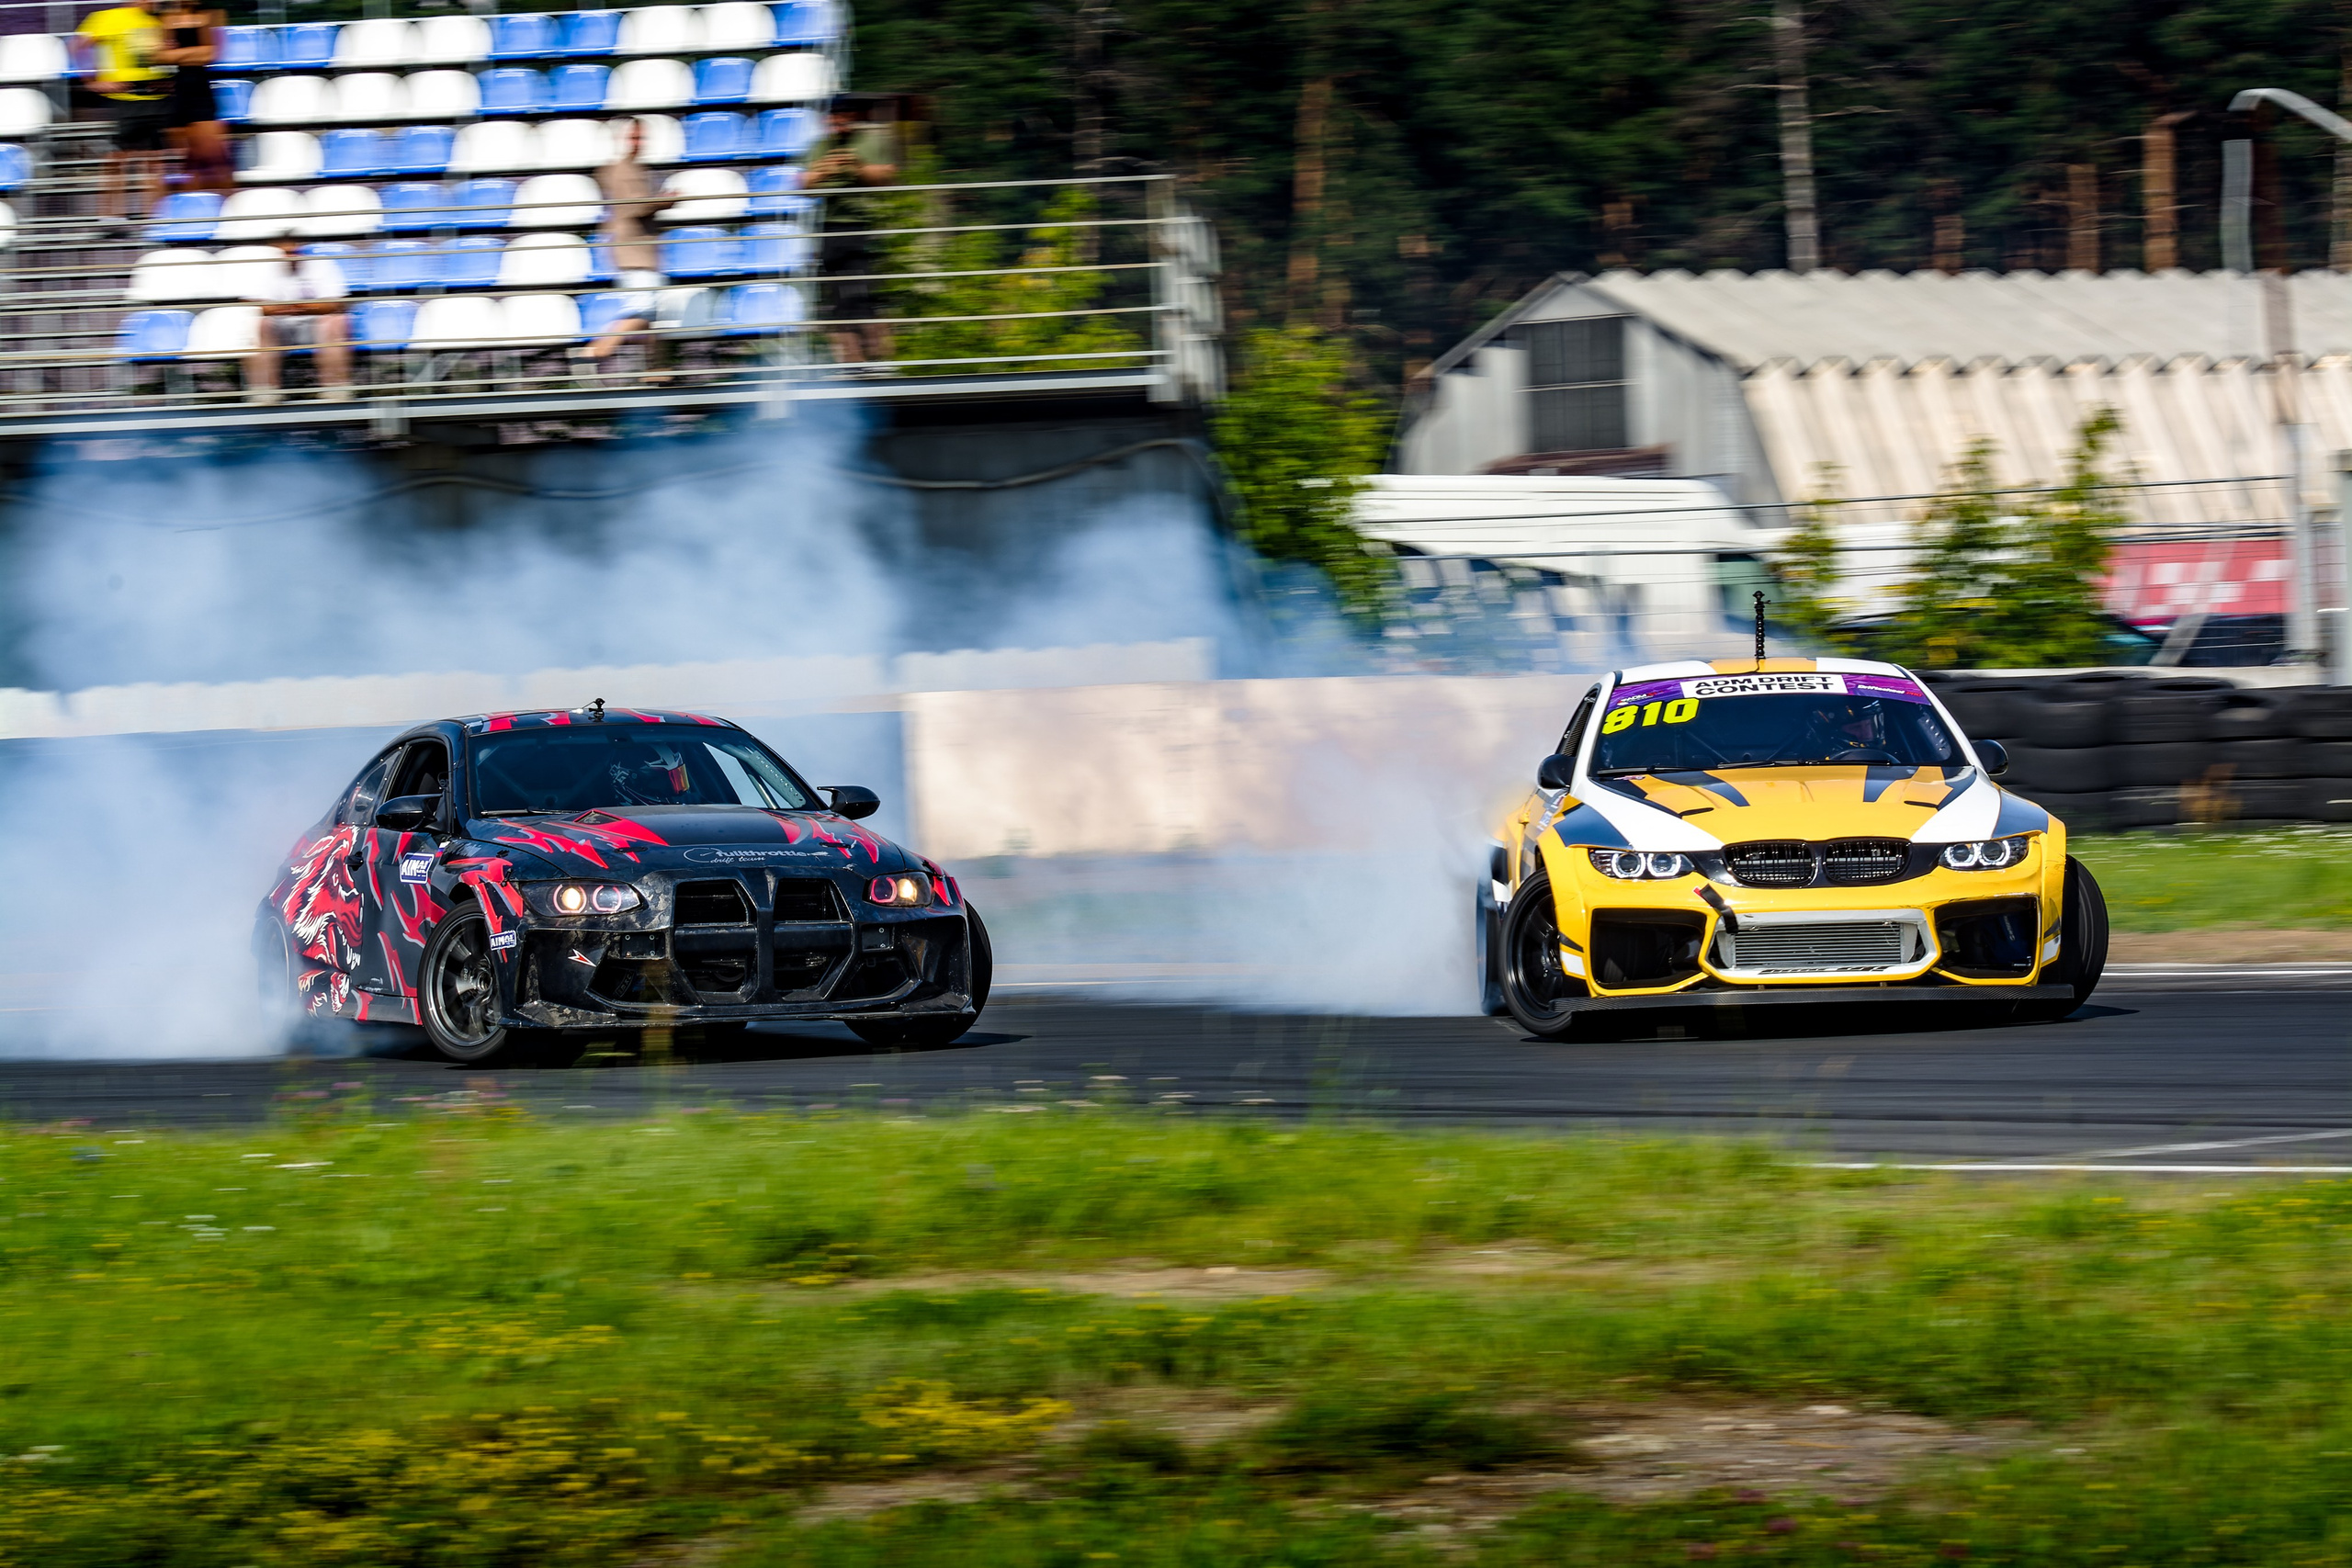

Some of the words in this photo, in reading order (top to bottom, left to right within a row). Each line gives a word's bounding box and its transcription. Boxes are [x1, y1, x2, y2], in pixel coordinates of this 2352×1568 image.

[1695, 678, 1752, 688] ADM
[1695, 682, 1834, 695] CONTEST
[1601, 698, 1700, 735] 810
[715, 849, 808, 857] fullthrottle
